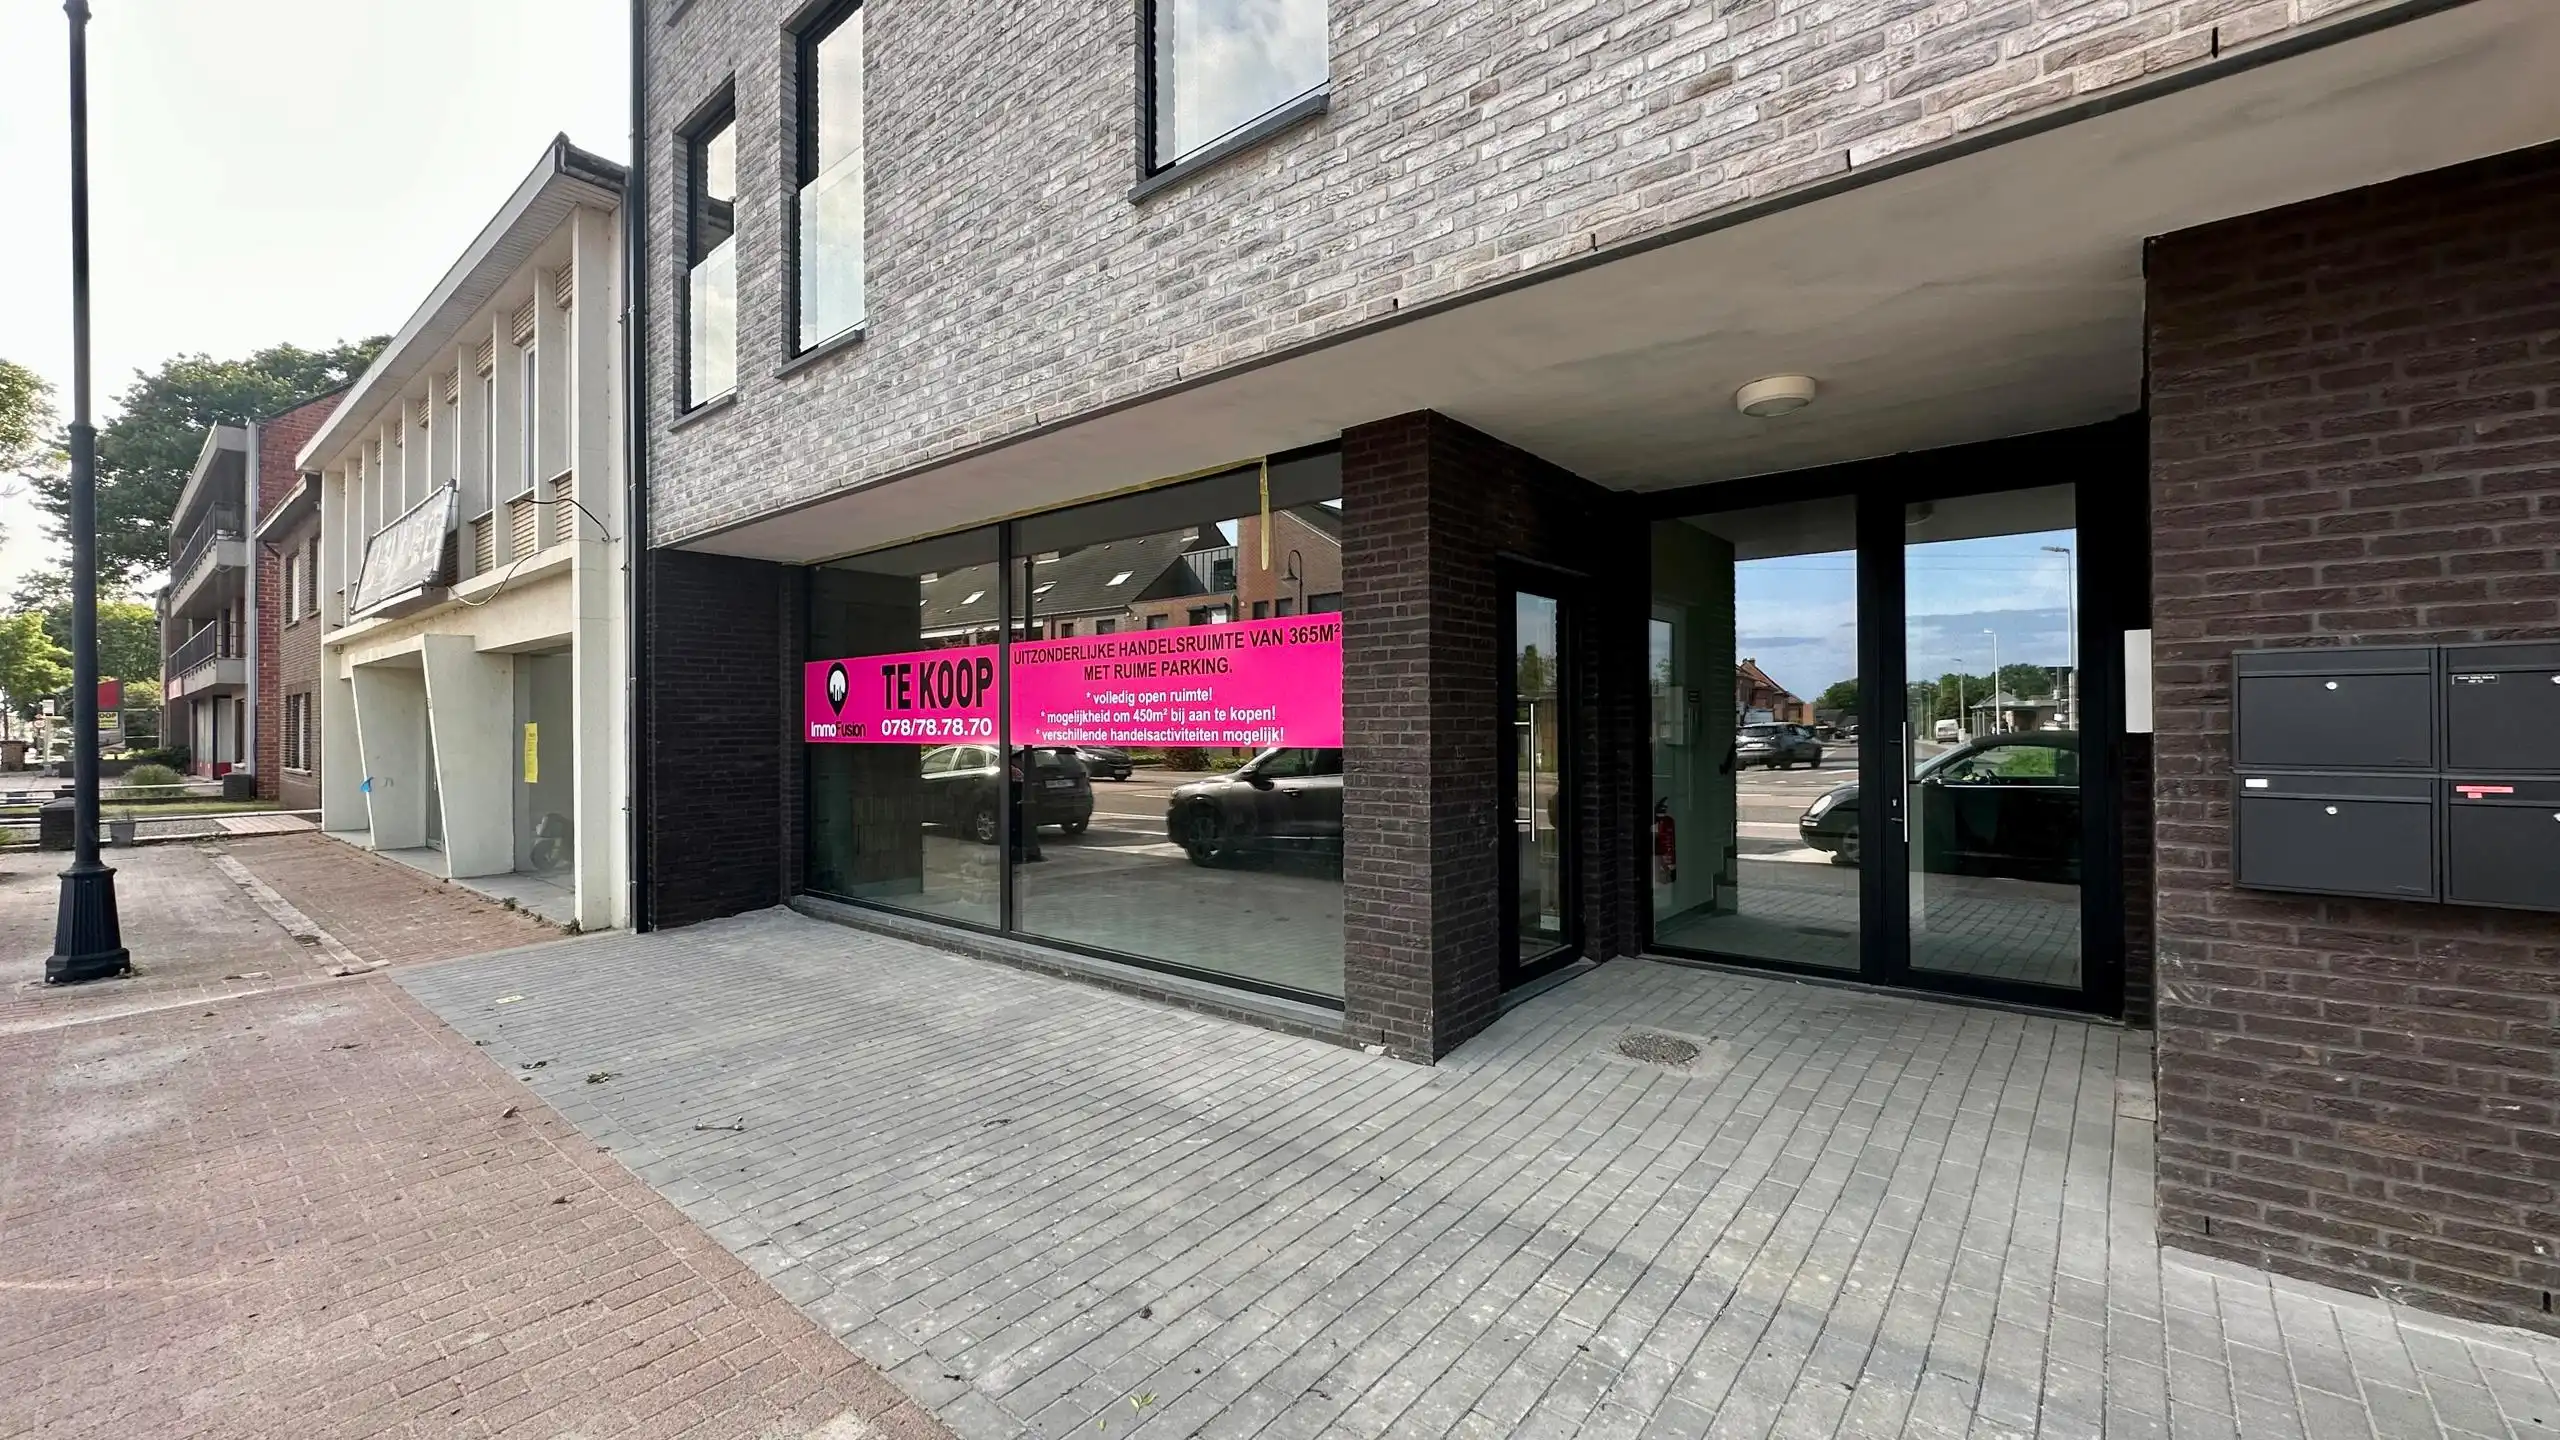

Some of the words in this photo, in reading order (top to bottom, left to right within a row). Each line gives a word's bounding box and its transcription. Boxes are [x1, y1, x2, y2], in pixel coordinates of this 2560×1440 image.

[1014, 643, 1115, 664] UITZONDERLIJKE
[1119, 632, 1244, 657] HANDELSRUIMTE
[1250, 628, 1283, 647] VAN
[1289, 623, 1340, 644] 365M²
[1084, 665, 1110, 680] MET
[1114, 662, 1157, 679] RUIME
[1161, 657, 1233, 676] PARKING.
[881, 664, 912, 711] TE
[919, 657, 993, 710] KOOP
[1093, 690, 1135, 707] volledig
[1138, 692, 1166, 705] open
[1169, 687, 1213, 702] ruimte!
[1047, 710, 1110, 726] mogelijkheid
[1113, 712, 1130, 723] om
[1132, 708, 1168, 723] 450m²
[1171, 708, 1185, 724] bij
[1188, 711, 1211, 721] aan
[1214, 708, 1227, 721] te
[1230, 706, 1276, 724] kopen!
[881, 718, 992, 737] 078/78.78.70
[1042, 728, 1107, 742] verschillende
[1110, 728, 1219, 742] handelsactiviteiten
[1222, 727, 1284, 745] mogelijk!
